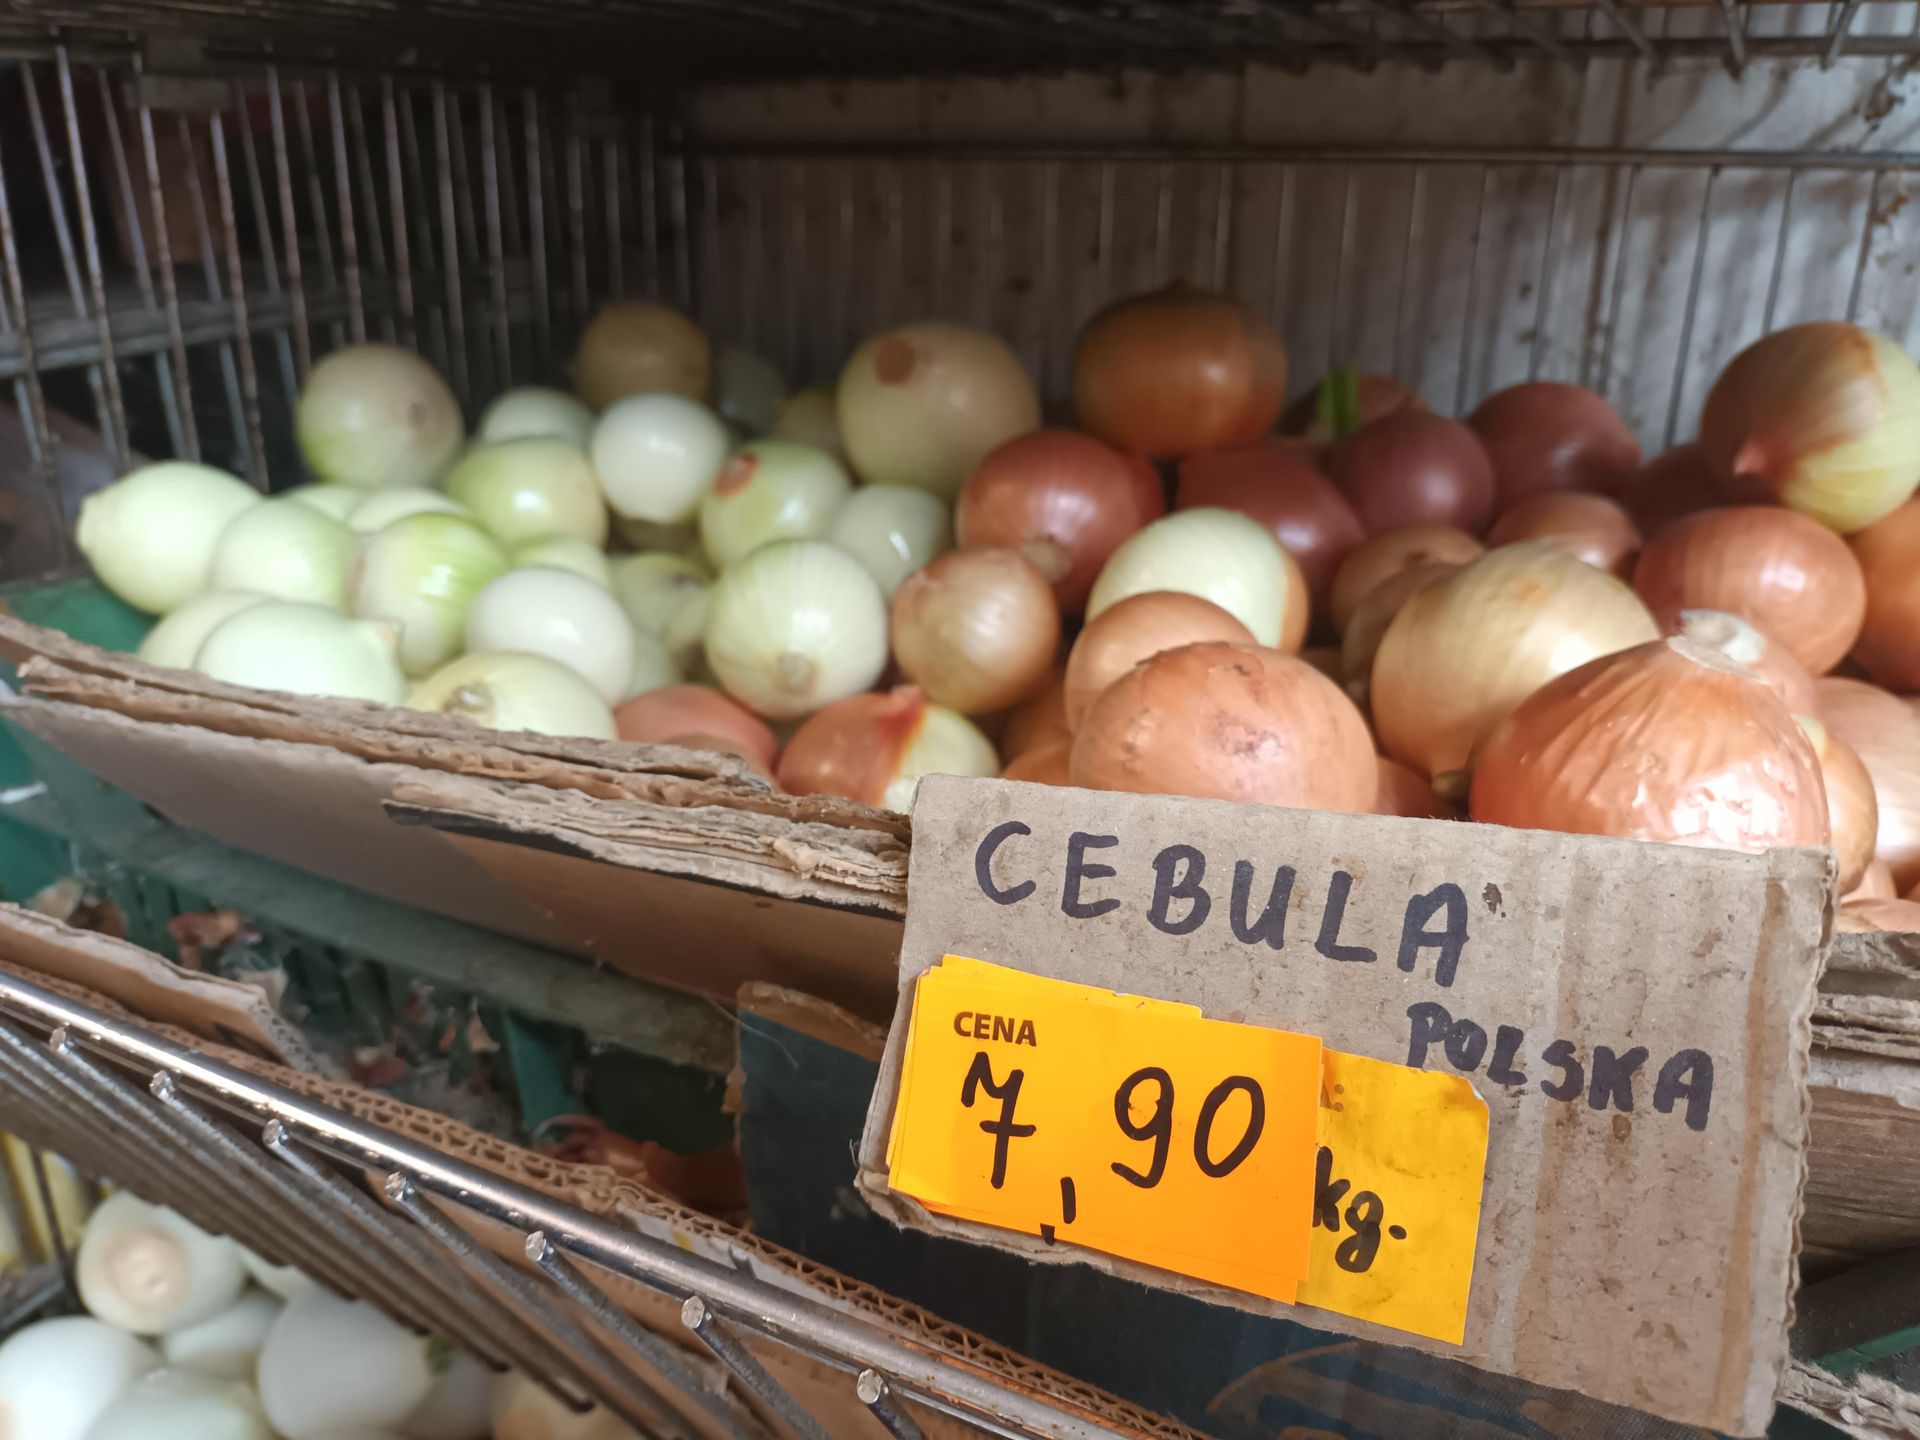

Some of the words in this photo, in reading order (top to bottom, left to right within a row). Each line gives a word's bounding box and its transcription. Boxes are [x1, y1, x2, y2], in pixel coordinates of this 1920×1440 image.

[975, 820, 1470, 988] CEBULA
[952, 1011, 1038, 1047] CENA
[1406, 1001, 1714, 1132] POLSKA
[960, 1051, 1266, 1225] 7,90
